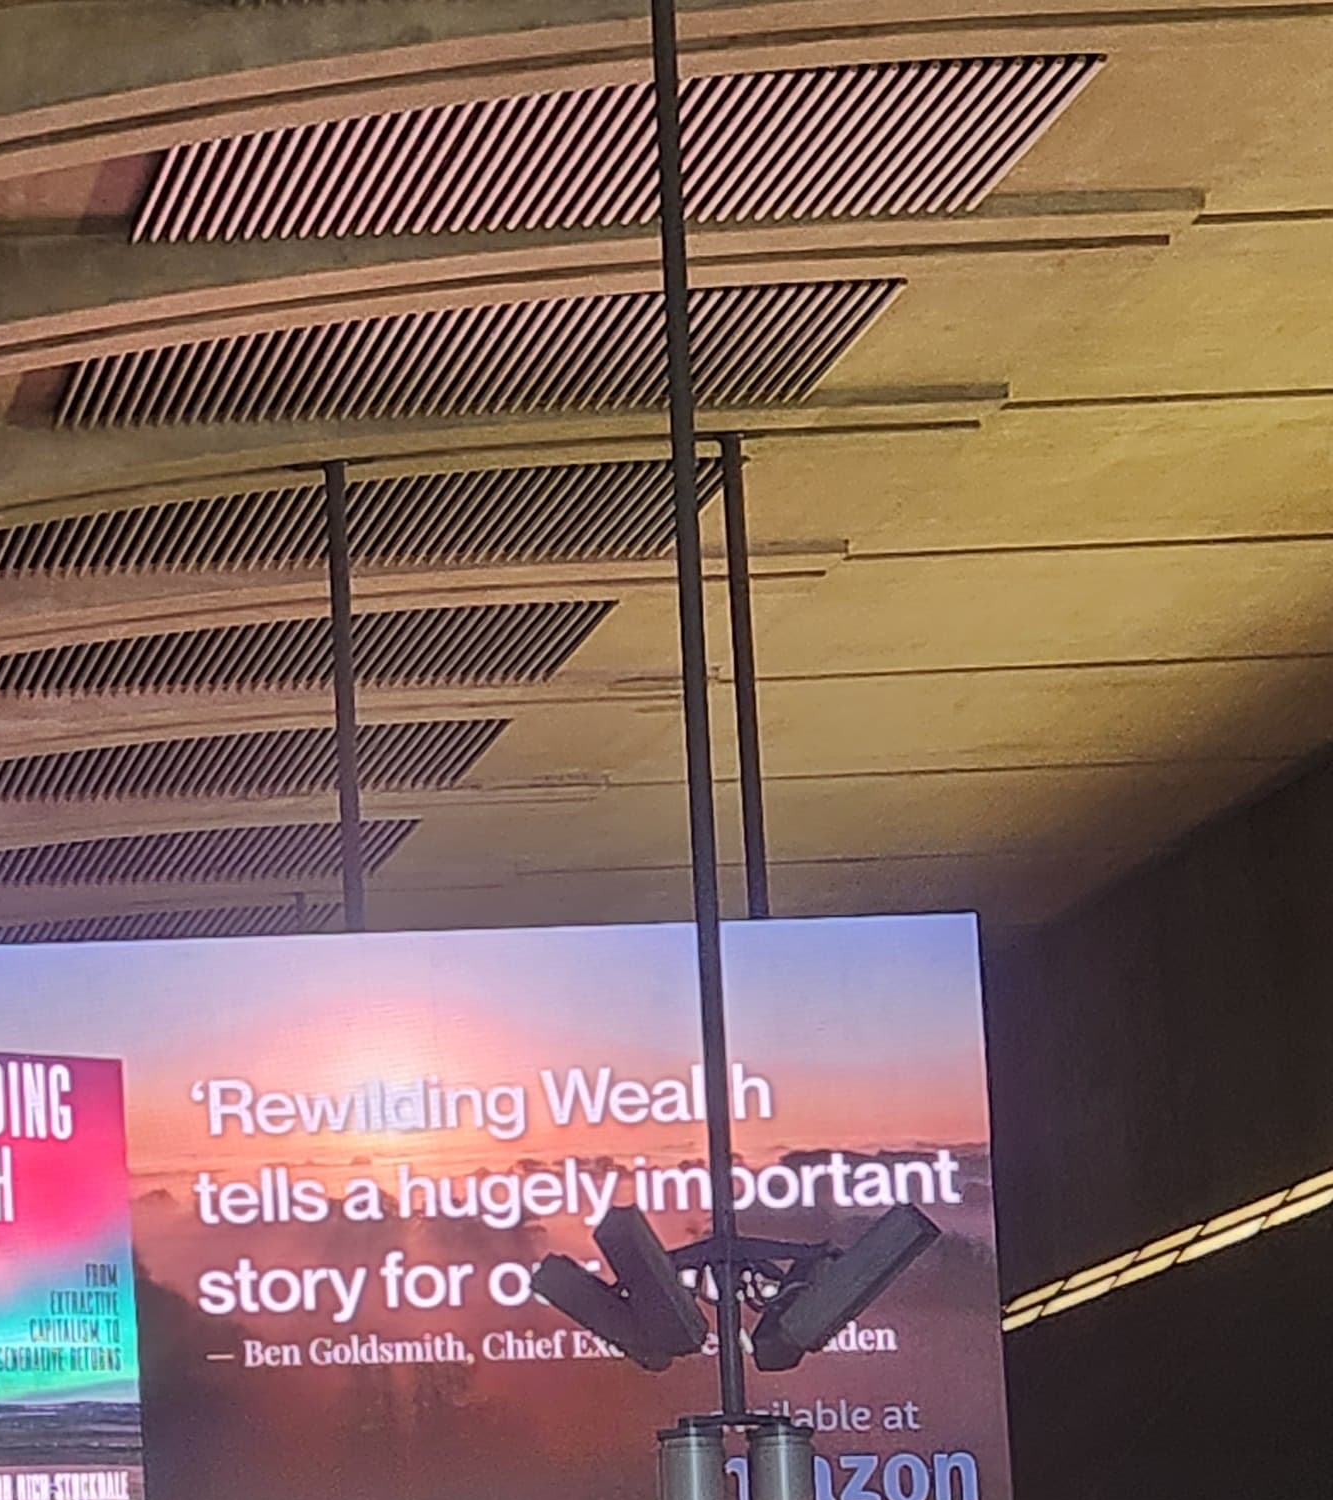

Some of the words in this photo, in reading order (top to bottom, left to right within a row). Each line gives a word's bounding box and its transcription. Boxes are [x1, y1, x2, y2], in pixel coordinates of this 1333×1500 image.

[542, 1063, 773, 1124] Wealh
[194, 1167, 328, 1226] tells
[343, 1177, 384, 1222] a
[399, 1160, 617, 1230] hugely
[85, 1263, 118, 1288] FROM
[199, 1260, 366, 1323] story
[380, 1251, 471, 1310] for
[50, 1289, 120, 1316] EXTRACTIVE
[29, 1317, 101, 1343] CAPITALISM
[105, 1317, 120, 1343] TO
[69, 1346, 122, 1372] RETURNS
[244, 1340, 301, 1368] Ben
[308, 1333, 474, 1367] Goldsmith,
[483, 1331, 565, 1362] Chief
[883, 1399, 922, 1431] at
